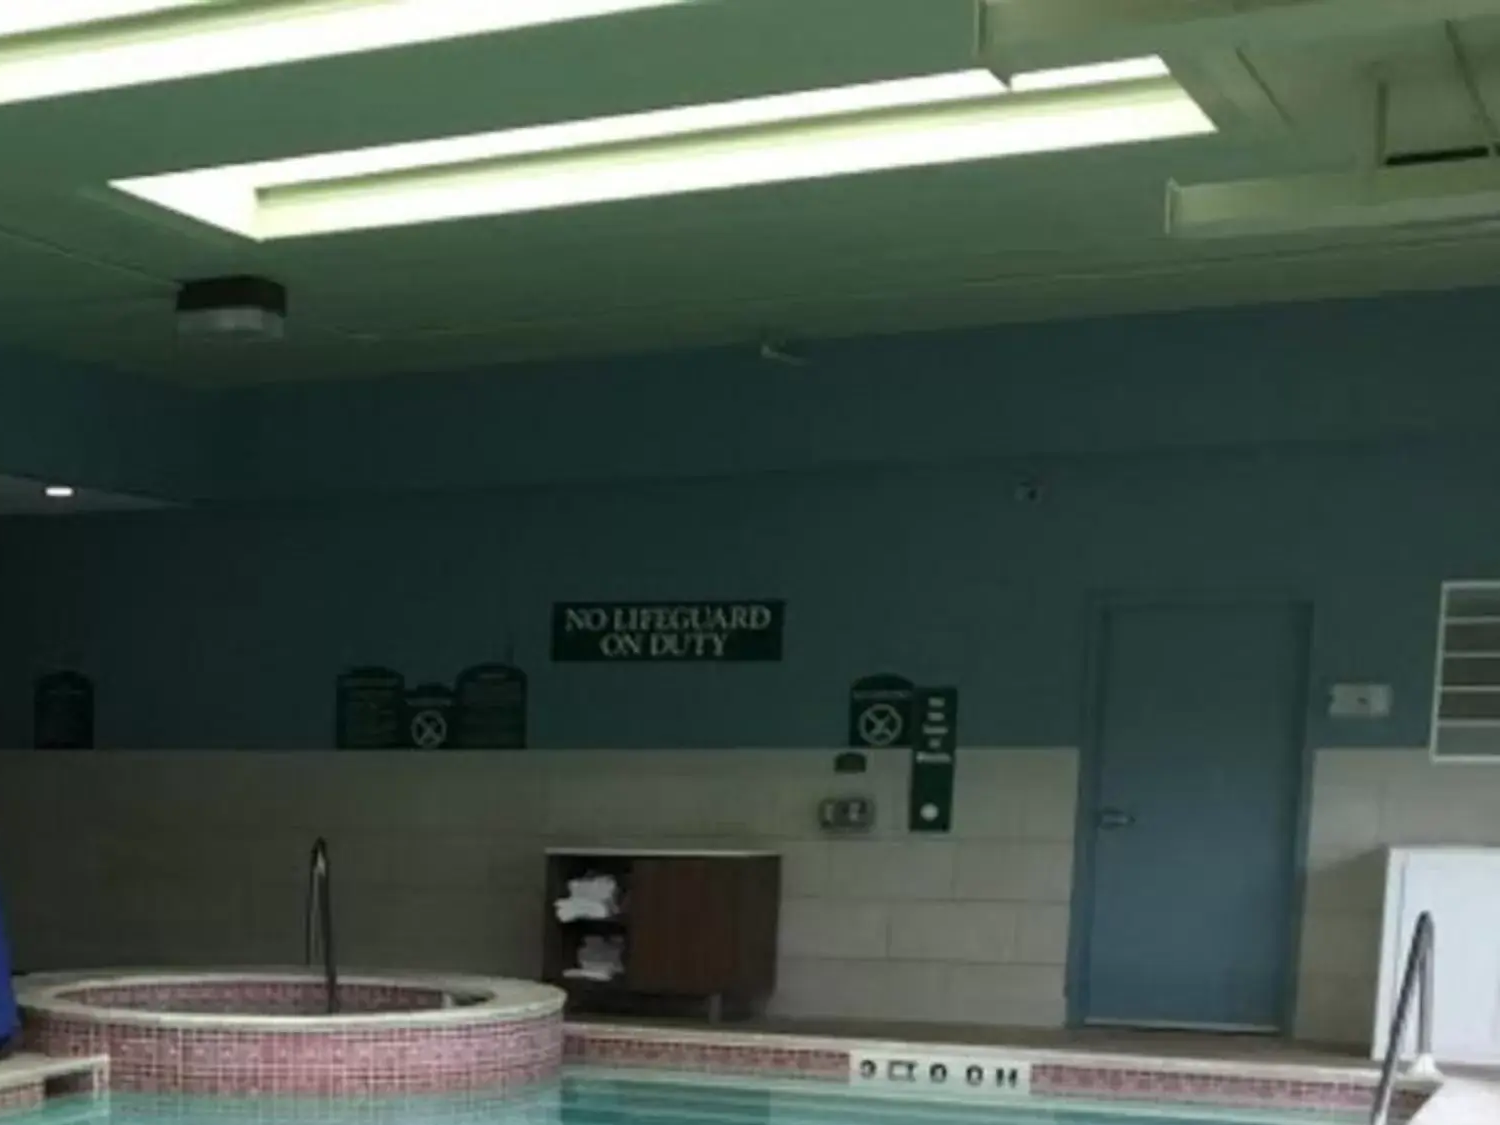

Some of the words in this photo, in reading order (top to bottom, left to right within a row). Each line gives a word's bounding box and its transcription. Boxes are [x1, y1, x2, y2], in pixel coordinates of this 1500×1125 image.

[564, 607, 608, 632] NO
[612, 605, 772, 632] LIFEGUARD
[599, 632, 642, 657] ON
[649, 632, 729, 657] DUTY
